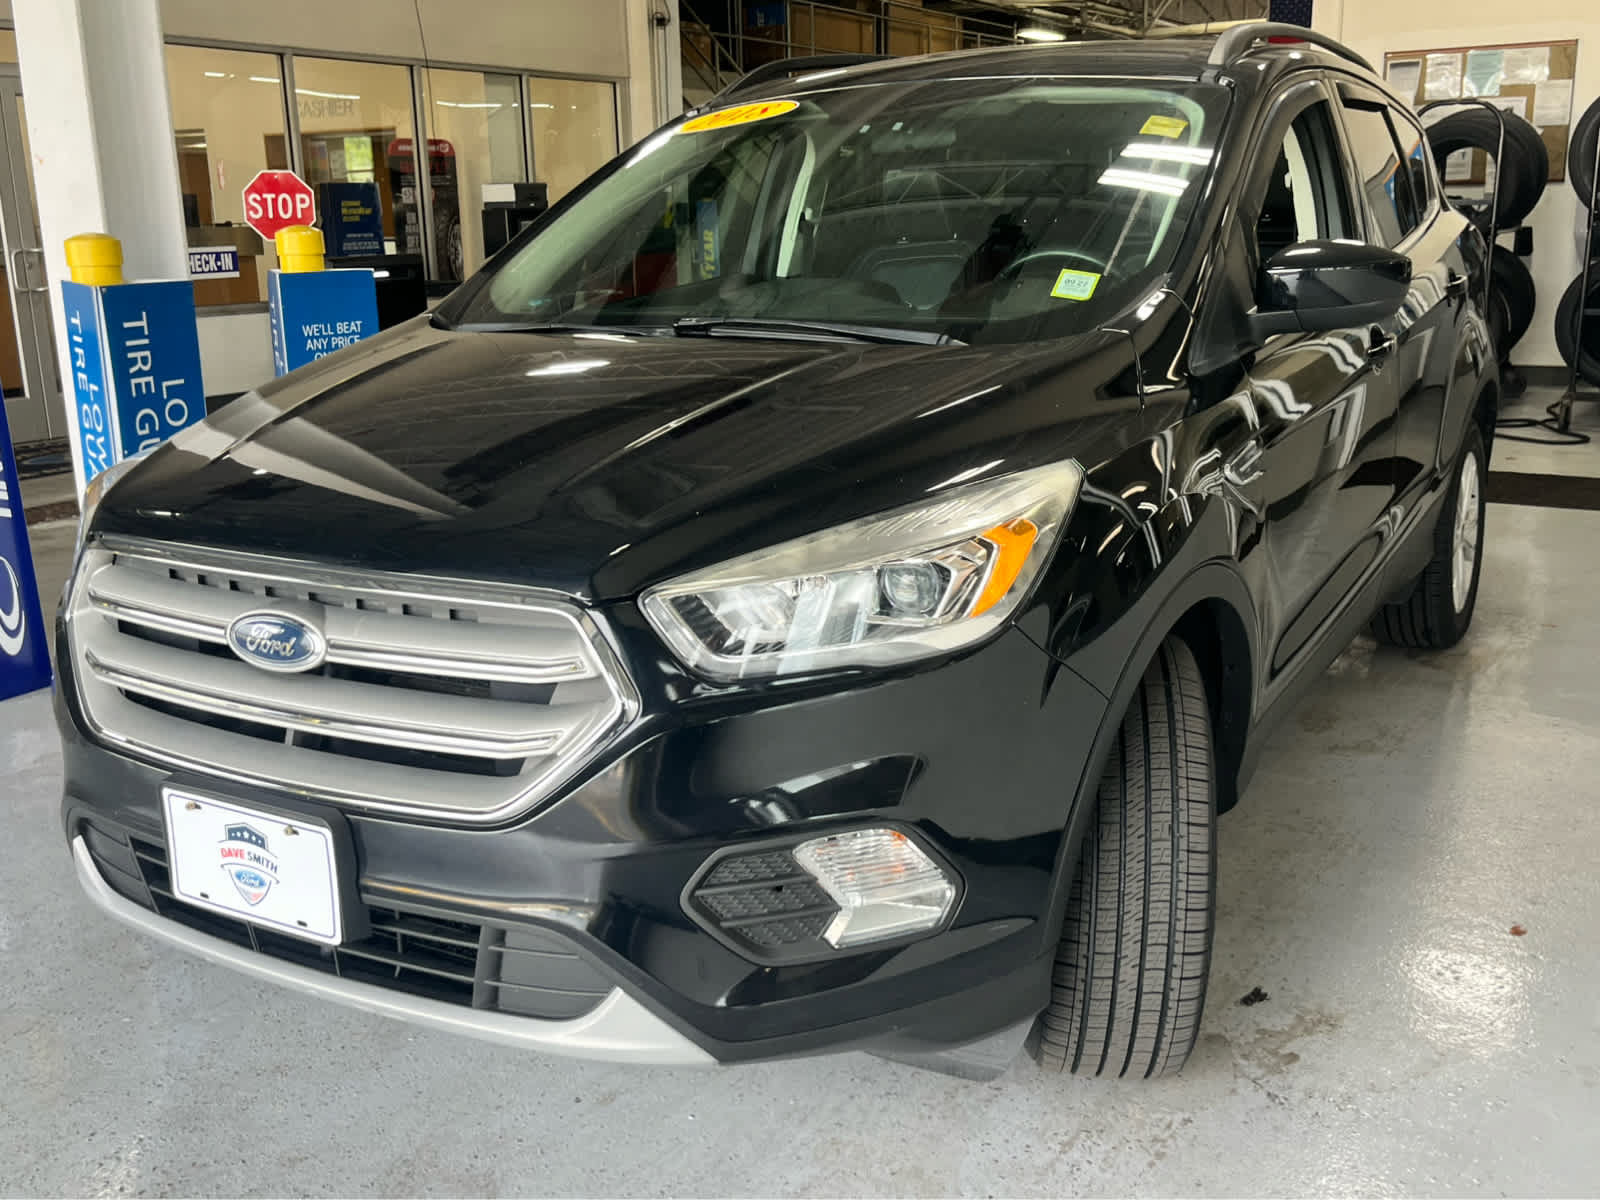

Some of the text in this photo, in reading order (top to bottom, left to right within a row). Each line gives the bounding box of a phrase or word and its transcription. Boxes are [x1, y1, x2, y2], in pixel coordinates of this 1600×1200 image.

[248, 193, 311, 219] STOP
[302, 321, 362, 337] WE'LL BEAT
[71, 311, 89, 391] TIRE
[123, 311, 156, 398] TIRE
[306, 338, 329, 351] ANY
[246, 623, 297, 656] Ford
[220, 847, 278, 874] DAVE SMITH
